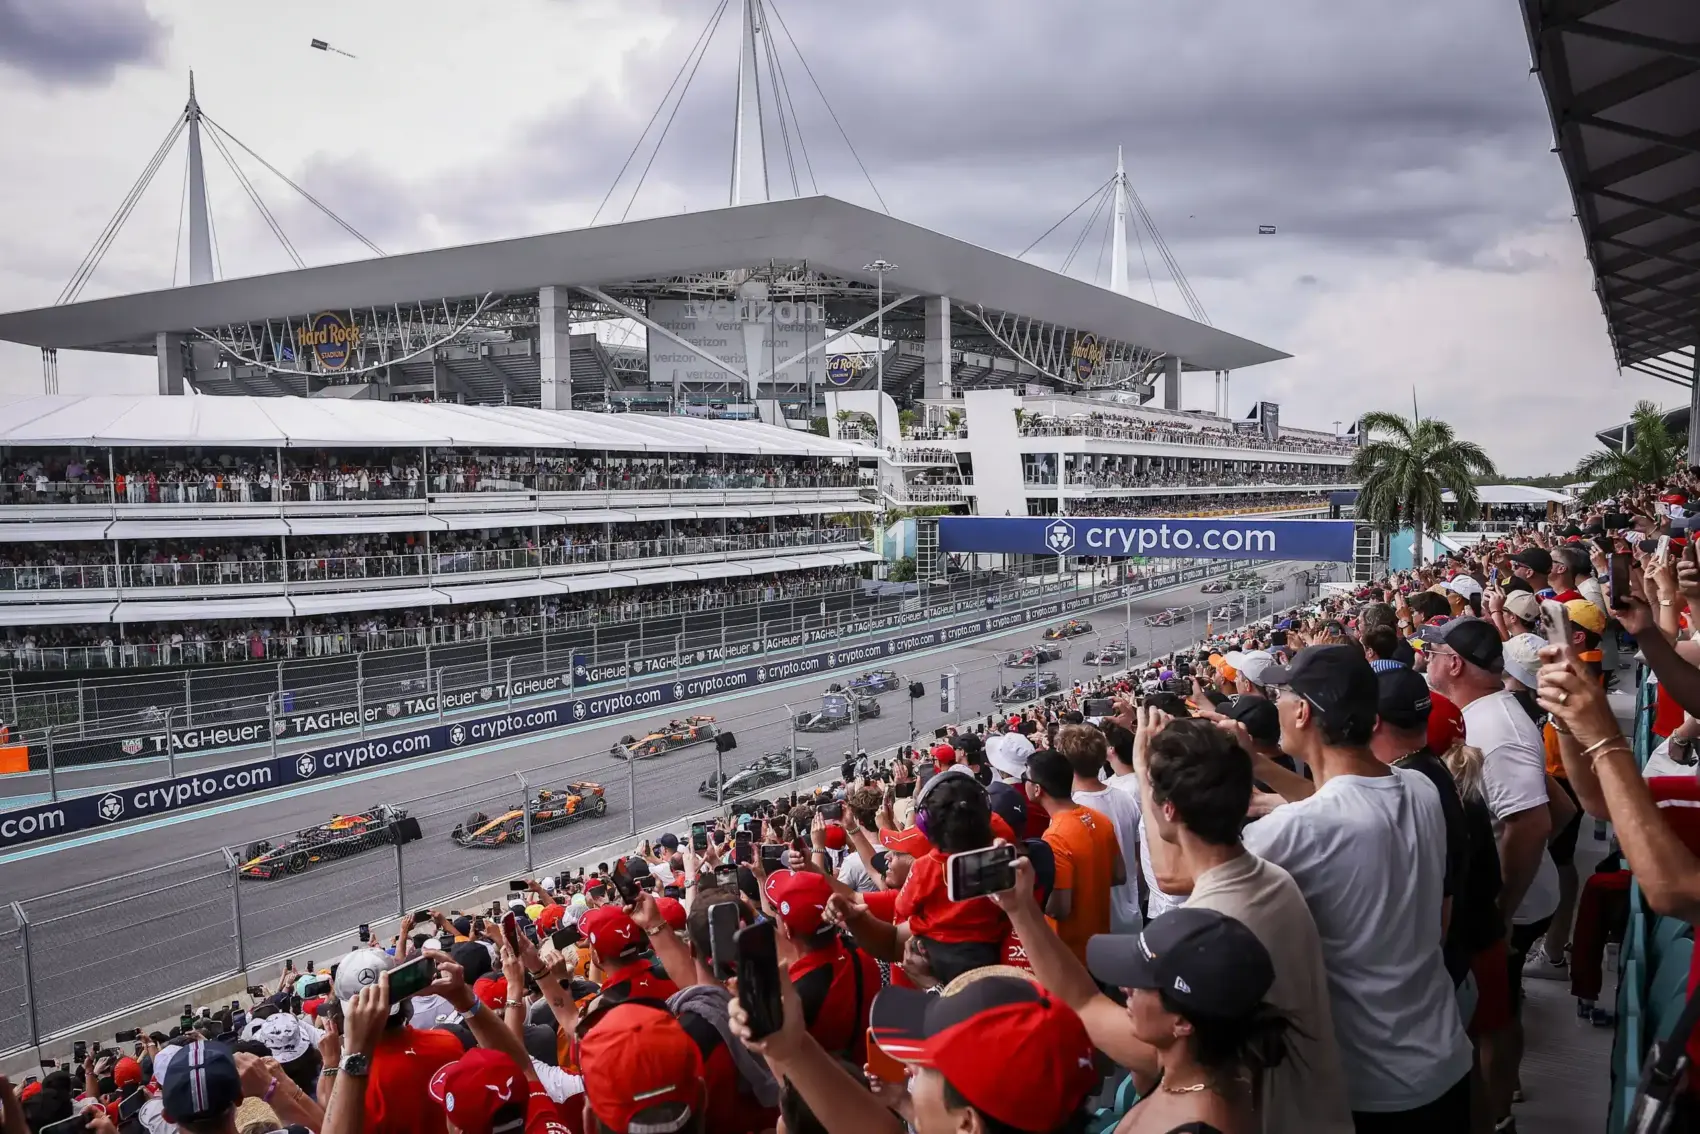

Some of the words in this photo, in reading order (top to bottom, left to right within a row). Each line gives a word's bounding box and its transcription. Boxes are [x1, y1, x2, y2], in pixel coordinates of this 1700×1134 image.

[691, 299, 820, 324] verizon
[298, 324, 327, 345] Hard
[329, 322, 360, 346] Rock
[716, 321, 743, 331] veriz
[777, 321, 819, 333] verizon
[654, 352, 696, 363] verizon
[686, 369, 728, 380] verizon
[1086, 524, 1276, 553] crypto.com
[1031, 605, 1058, 619] crypto.com
[1066, 597, 1090, 610] crypto.com
[992, 614, 1022, 628] crypto.com
[948, 623, 981, 638] crypto.com
[896, 633, 935, 650] crypto.com
[837, 646, 881, 663] crypto.com
[769, 658, 819, 678] crypto.com
[688, 672, 747, 694] crypto.com
[590, 688, 661, 713] crypto.com
[471, 708, 558, 738] crypto.com
[323, 733, 431, 769] crypto.com
[134, 765, 272, 808] crypto.com
